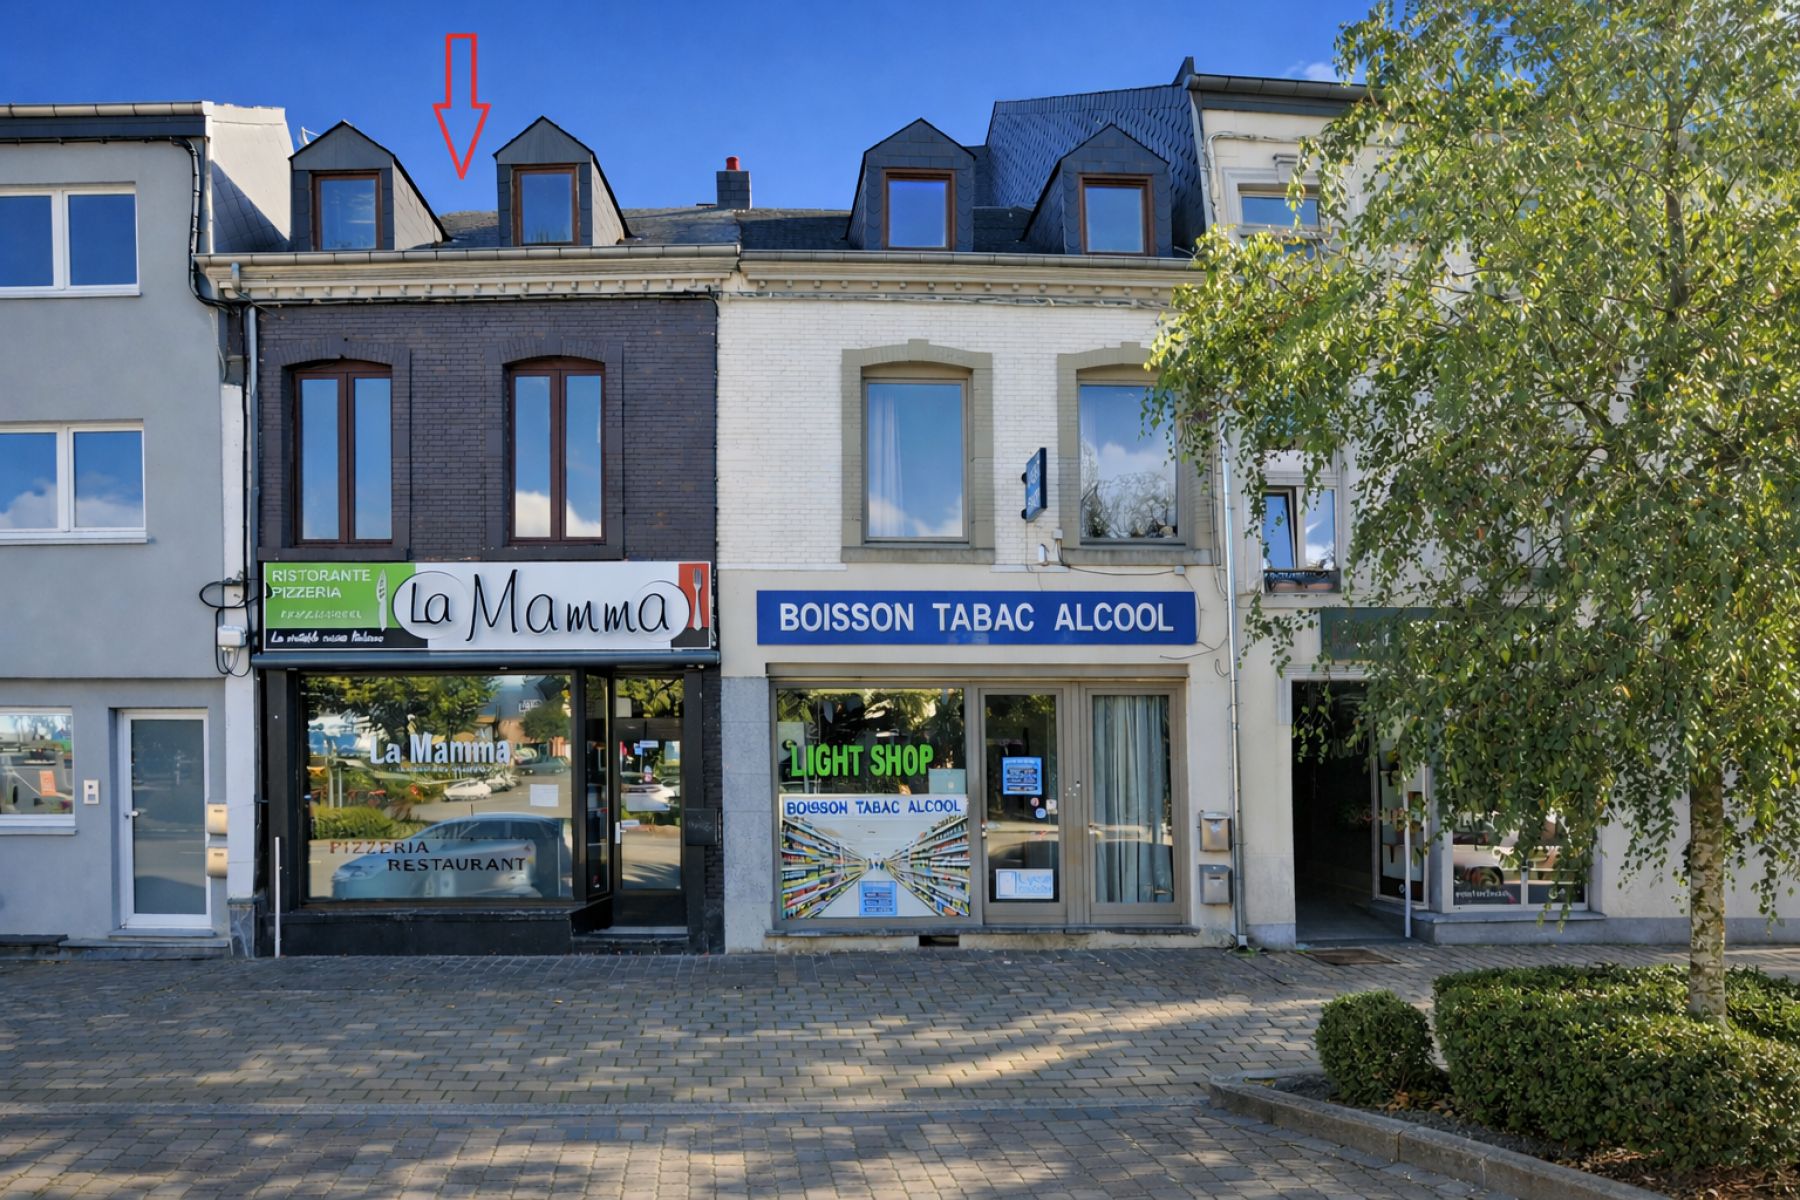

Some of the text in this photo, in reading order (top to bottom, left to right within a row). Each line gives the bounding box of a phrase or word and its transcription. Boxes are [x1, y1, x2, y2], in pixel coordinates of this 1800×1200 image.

[272, 569, 372, 582] RISTORANTE
[272, 586, 342, 599] PIZZERIA
[410, 569, 670, 642] La Mamma
[780, 602, 1174, 632] BOISSON TABAC ALCOOL
[369, 731, 511, 764] La Mamma
[791, 743, 934, 777] LIGHT SHOP
[855, 800, 900, 814] TABAC
[908, 799, 962, 813] ALCOOL
[329, 840, 430, 854] PIZZERIA
[387, 857, 526, 872] RESTAURANT
